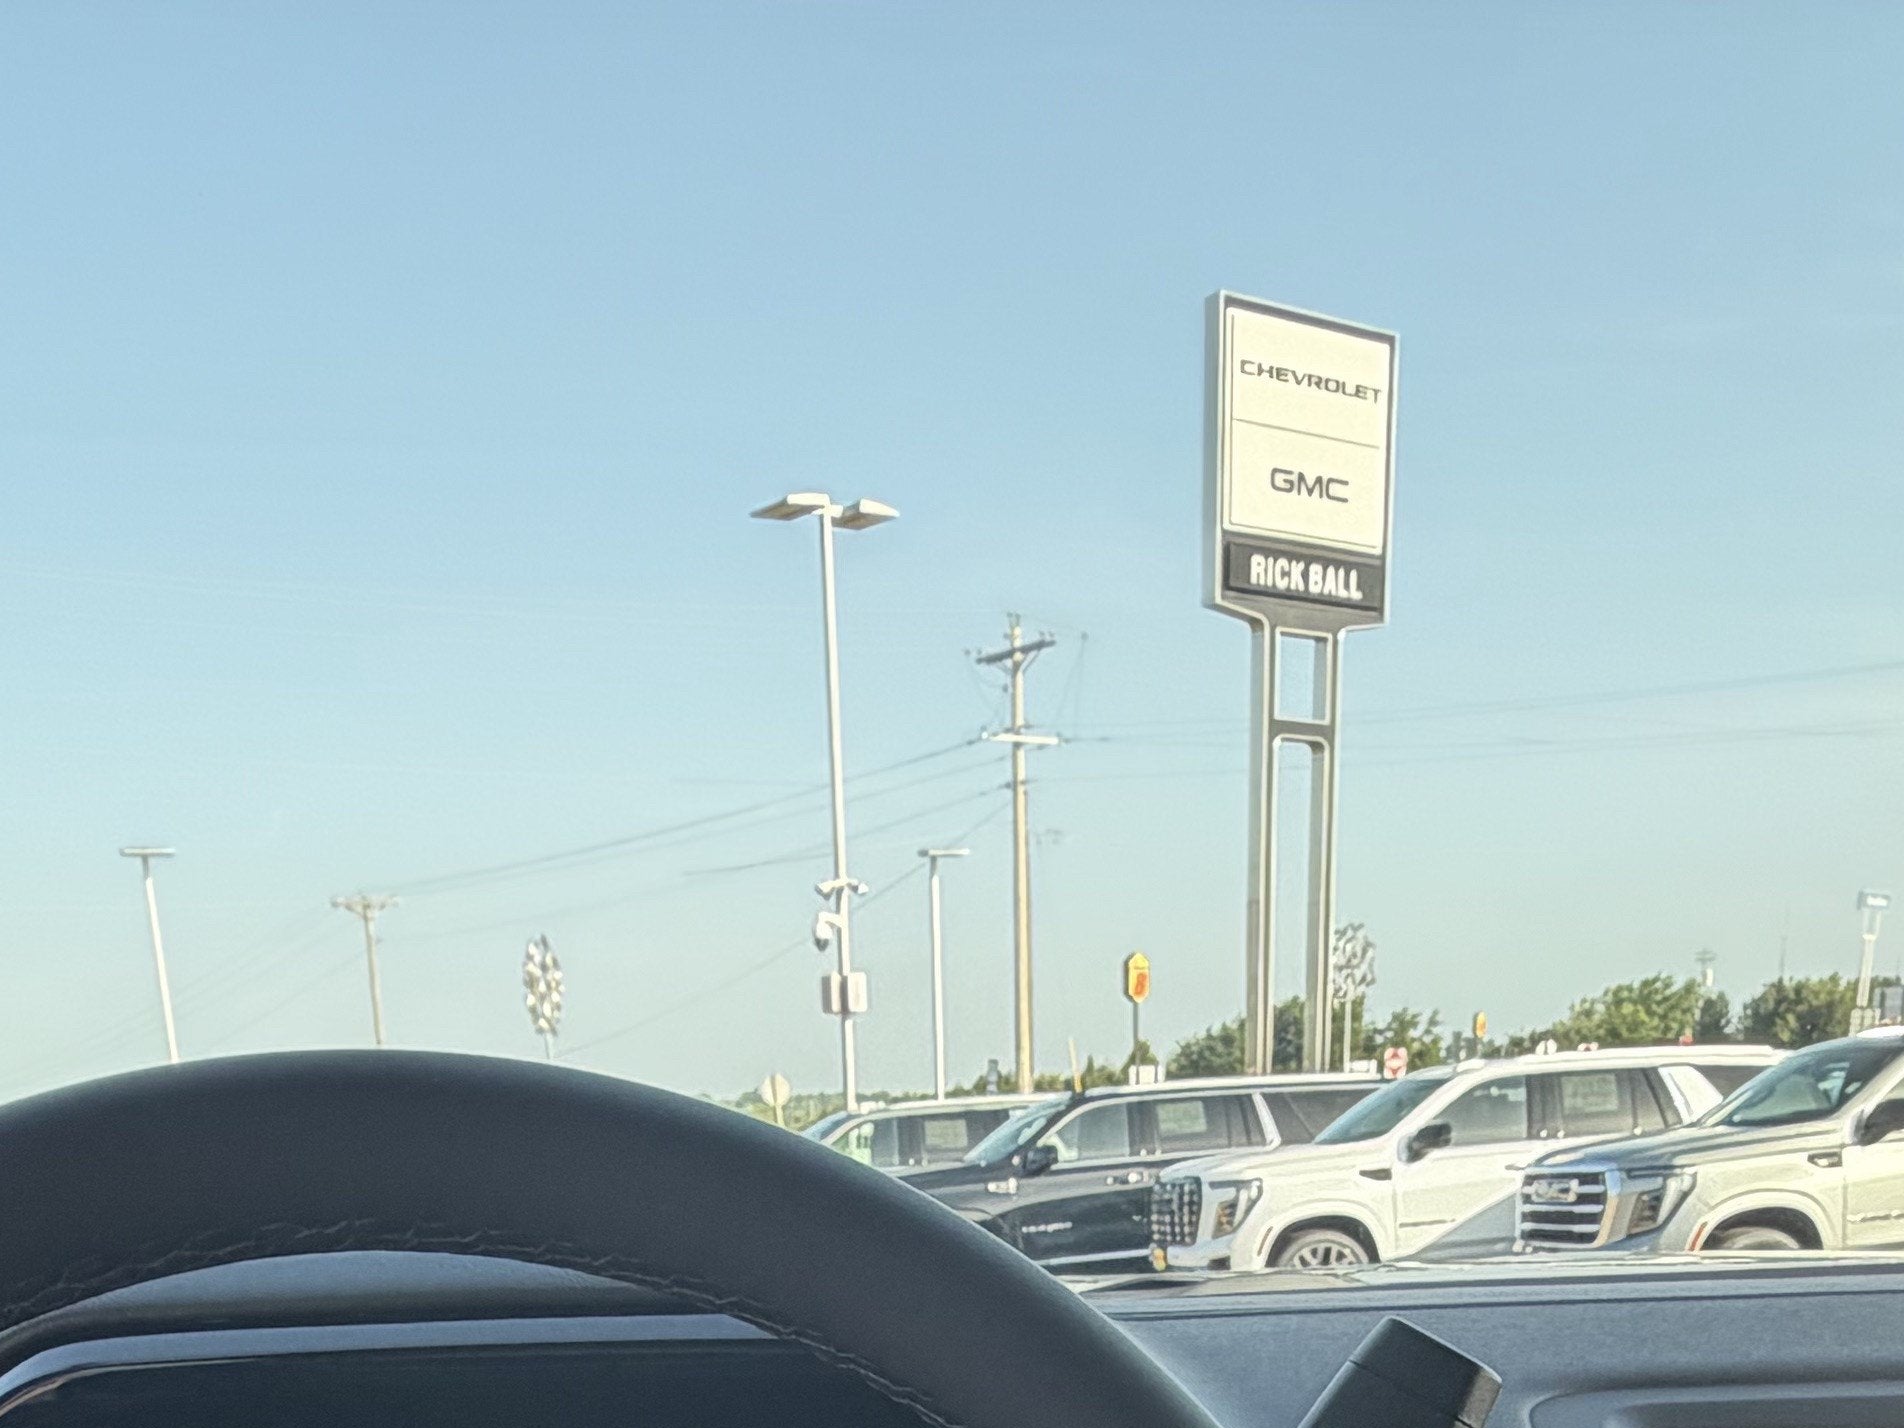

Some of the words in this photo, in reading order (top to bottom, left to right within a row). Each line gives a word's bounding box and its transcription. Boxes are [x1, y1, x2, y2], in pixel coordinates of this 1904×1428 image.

[1239, 358, 1382, 404] CHEVROLET
[1270, 467, 1350, 503] GMC
[1249, 553, 1306, 592] RICK
[1308, 563, 1363, 600] BALL
